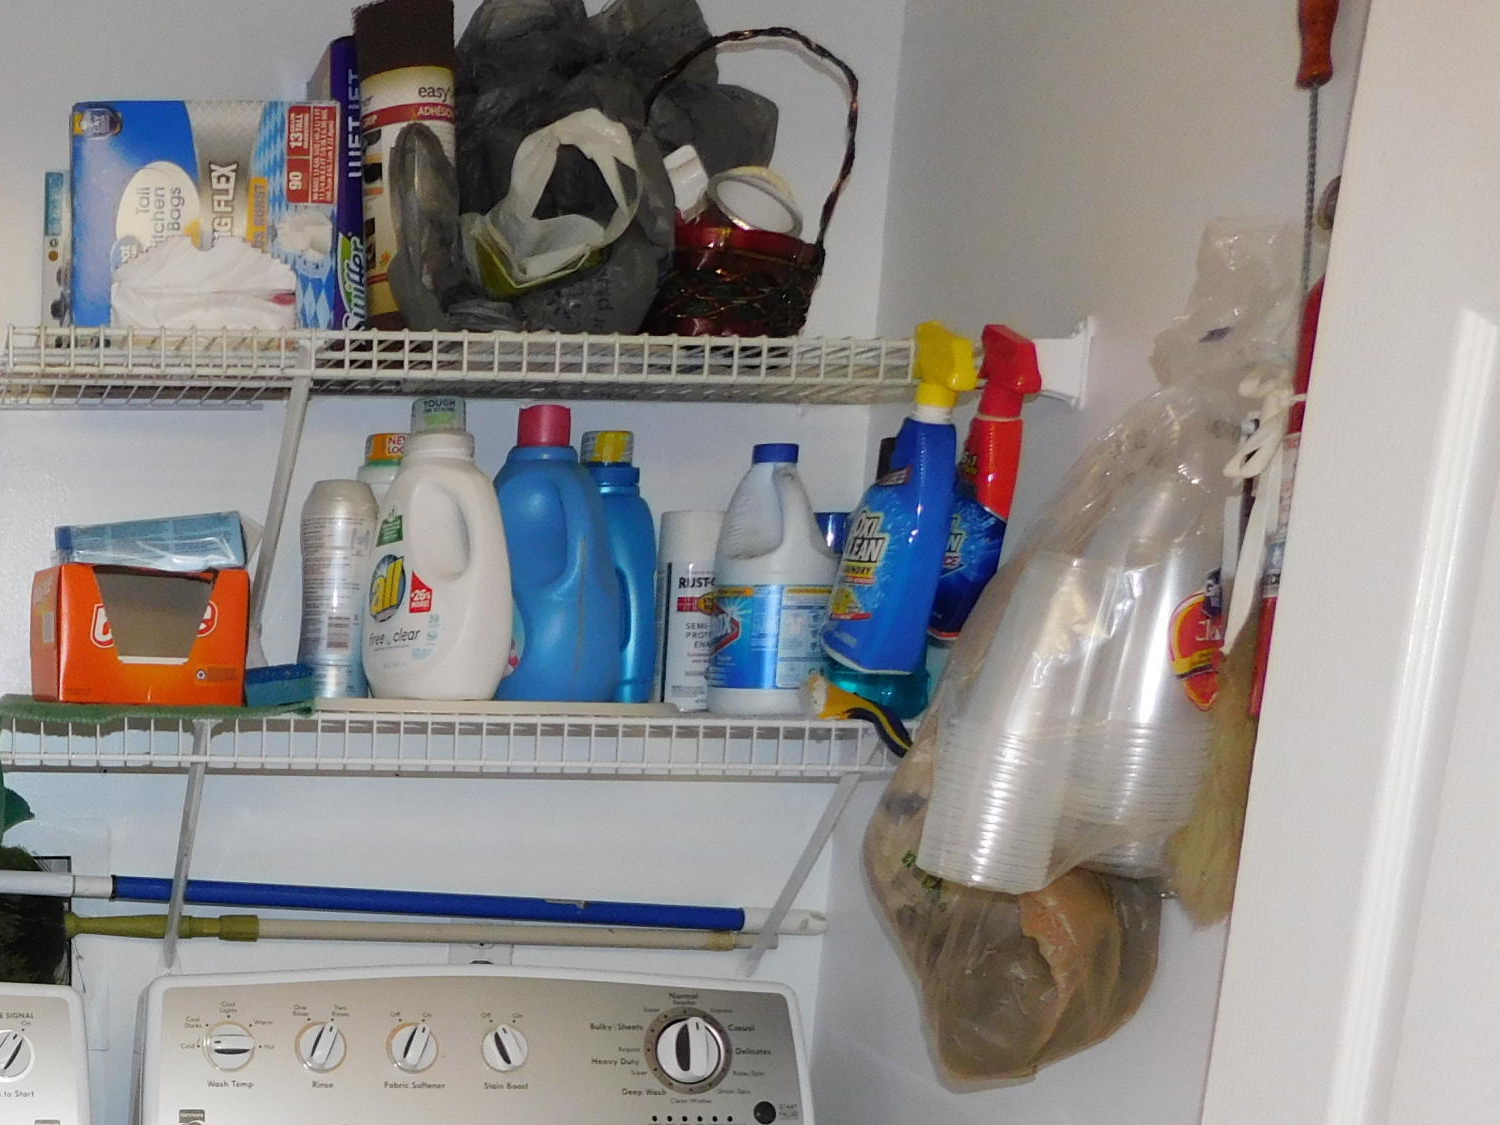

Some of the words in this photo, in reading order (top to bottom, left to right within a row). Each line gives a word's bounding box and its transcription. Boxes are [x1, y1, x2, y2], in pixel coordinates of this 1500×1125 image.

[418, 87, 451, 102] easy
[289, 132, 303, 148] 13
[210, 162, 238, 213] FLEX
[289, 171, 303, 190] 90
[136, 187, 150, 215] Tall
[152, 187, 165, 245] itchen
[167, 187, 185, 232] Bags
[423, 399, 455, 409] TOUGH
[388, 436, 405, 446] NE
[844, 538, 885, 563] LEAN
[371, 558, 404, 615] all
[393, 628, 421, 642] clear
[668, 992, 698, 1000] Normal
[591, 1058, 617, 1066] Heavy
[620, 1058, 640, 1066] Duty
[232, 1081, 254, 1089] Temp
[384, 1081, 409, 1089] Fabric
[411, 1081, 446, 1089] Softener
[484, 1082, 503, 1090] Stain
[506, 1082, 529, 1090] Boost
[622, 1088, 643, 1096] Deep
[645, 1088, 667, 1096] Wash
[4, 1090, 12, 1098] to
[14, 1090, 35, 1098] Start
